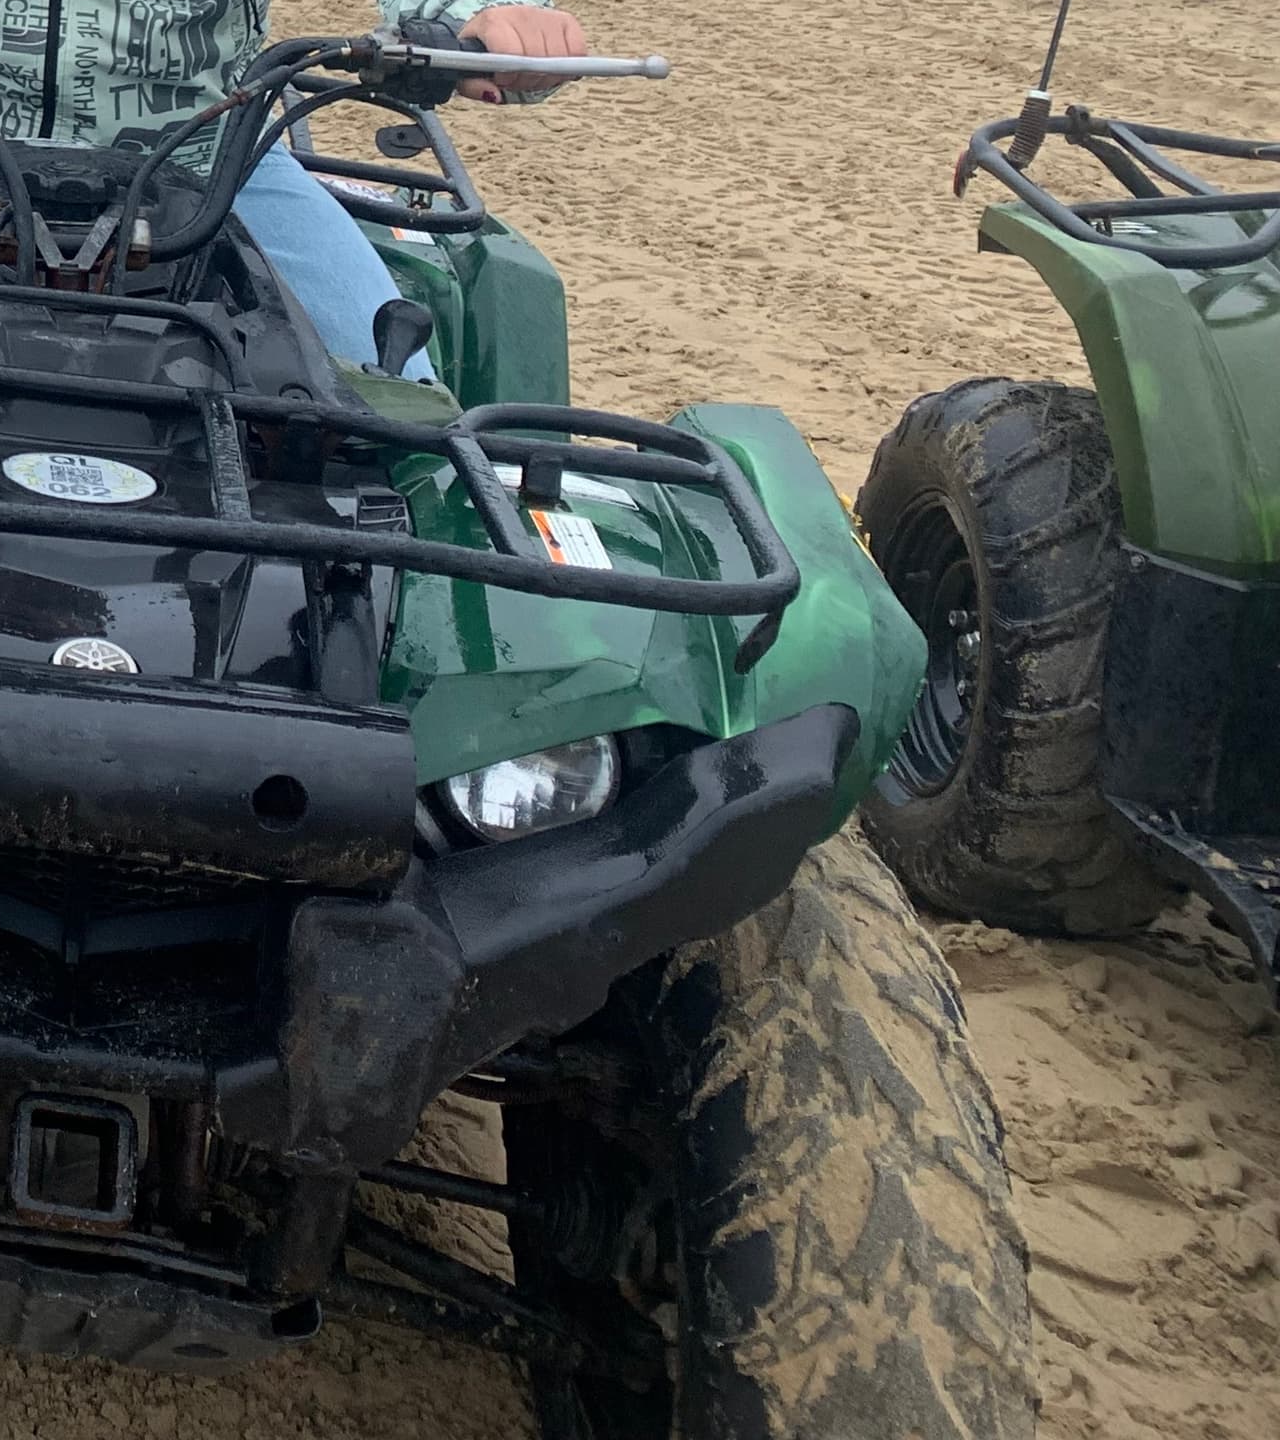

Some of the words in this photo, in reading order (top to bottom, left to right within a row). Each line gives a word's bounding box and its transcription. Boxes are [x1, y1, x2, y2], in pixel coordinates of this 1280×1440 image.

[76, 9, 103, 40] THE
[49, 455, 101, 469] QL
[48, 482, 112, 498] 062
